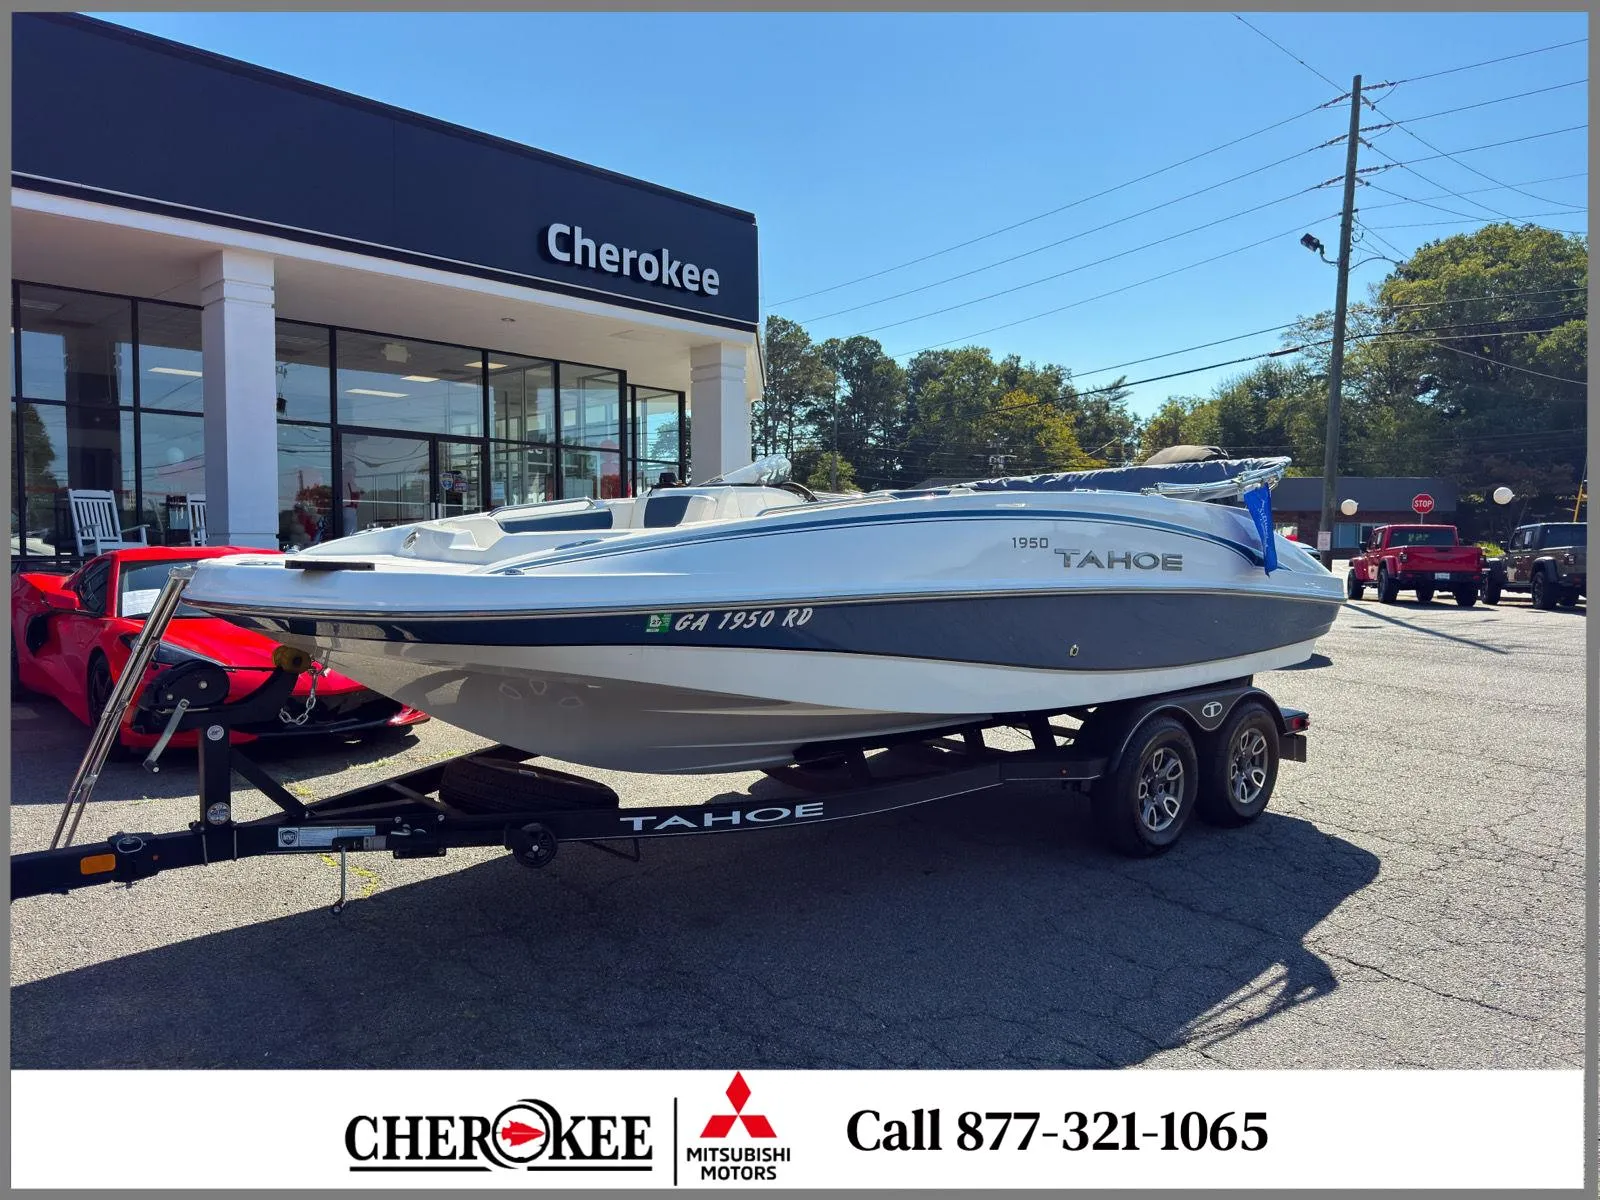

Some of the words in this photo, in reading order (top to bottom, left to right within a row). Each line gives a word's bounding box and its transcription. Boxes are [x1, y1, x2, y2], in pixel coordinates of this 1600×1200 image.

[547, 223, 720, 296] Cherokee
[1414, 499, 1433, 508] STOP
[1012, 537, 1048, 548] 1950
[1054, 548, 1184, 571] TAHOE
[674, 613, 709, 631] GA
[717, 610, 775, 630] 1950
[782, 607, 814, 628] RD
[619, 802, 824, 831] TAHOE
